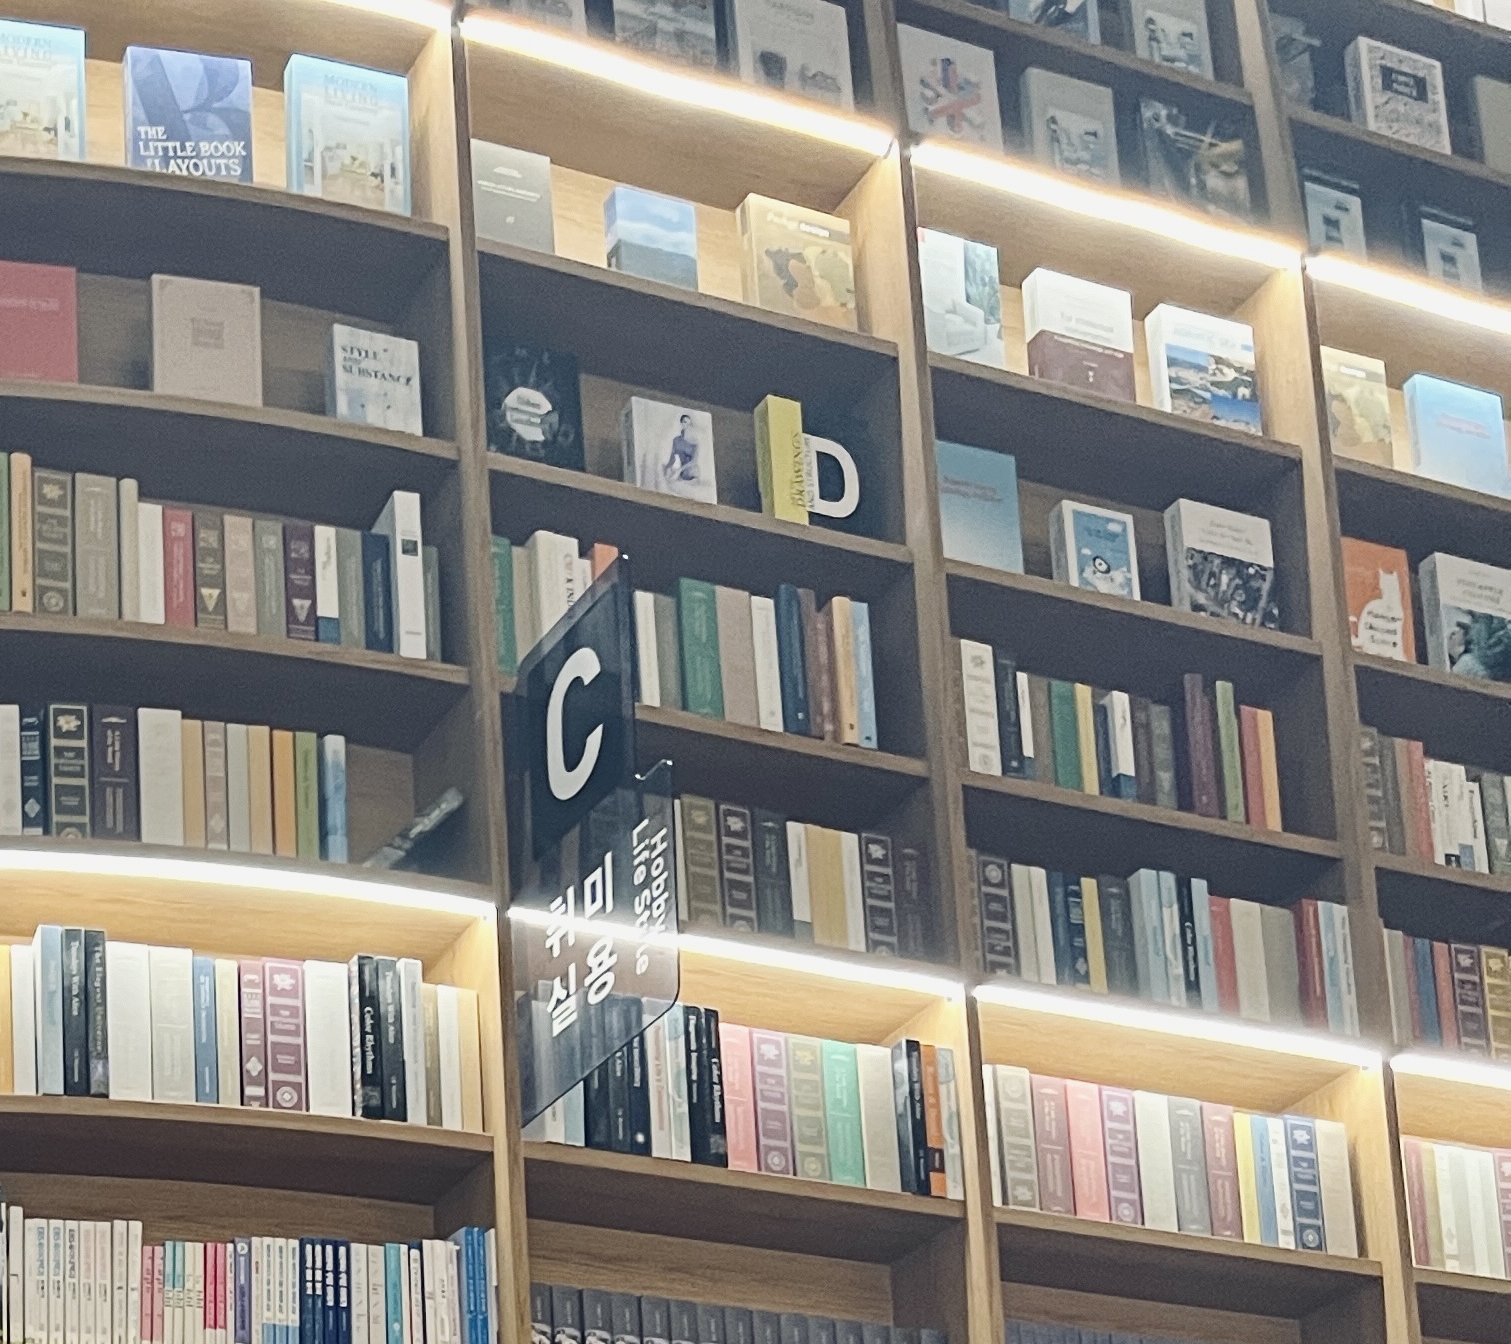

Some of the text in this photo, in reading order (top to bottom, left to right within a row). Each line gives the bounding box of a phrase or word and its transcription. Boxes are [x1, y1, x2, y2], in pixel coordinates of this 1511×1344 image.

[136, 125, 168, 140] THE
[138, 141, 247, 157] LITTLE BOOK
[341, 345, 378, 361] STYLE
[342, 364, 413, 387] SUBSTANCE
[801, 431, 860, 518] D
[547, 647, 603, 801] C
[632, 819, 652, 977] Life Stle
[545, 935, 618, 1039] 실용
[363, 1007, 374, 1033] Color
